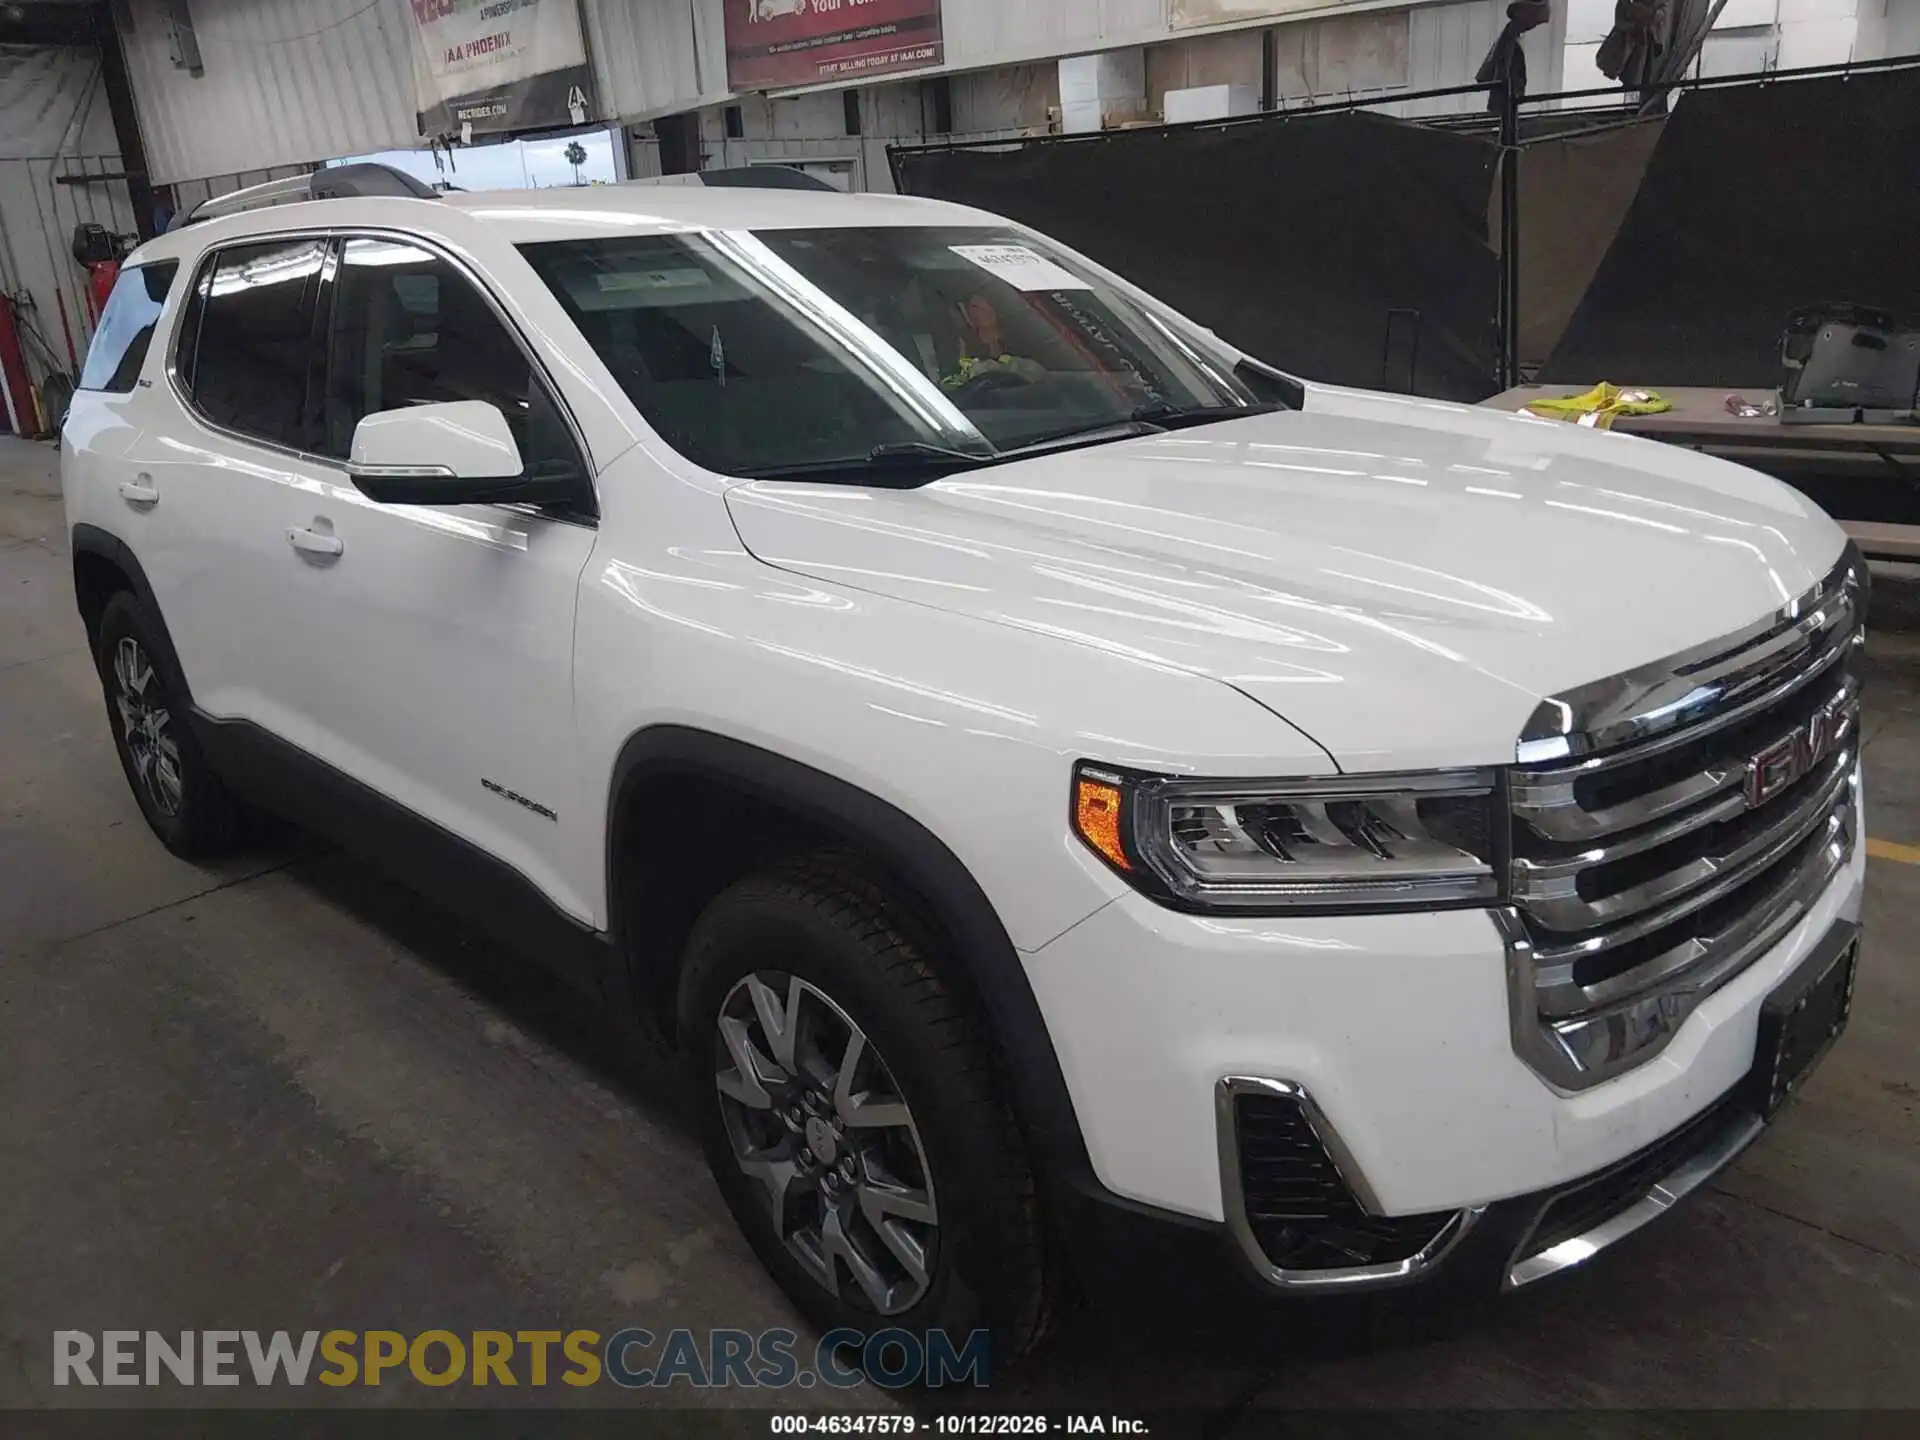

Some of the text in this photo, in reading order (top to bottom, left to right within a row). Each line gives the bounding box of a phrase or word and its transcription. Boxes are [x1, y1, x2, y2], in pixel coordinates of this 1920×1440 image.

[443, 45, 464, 66] IAA
[466, 31, 511, 58] PHOENIX
[840, 60, 866, 72] SELLING
[867, 55, 889, 67] TODAY
[890, 53, 899, 63] AT
